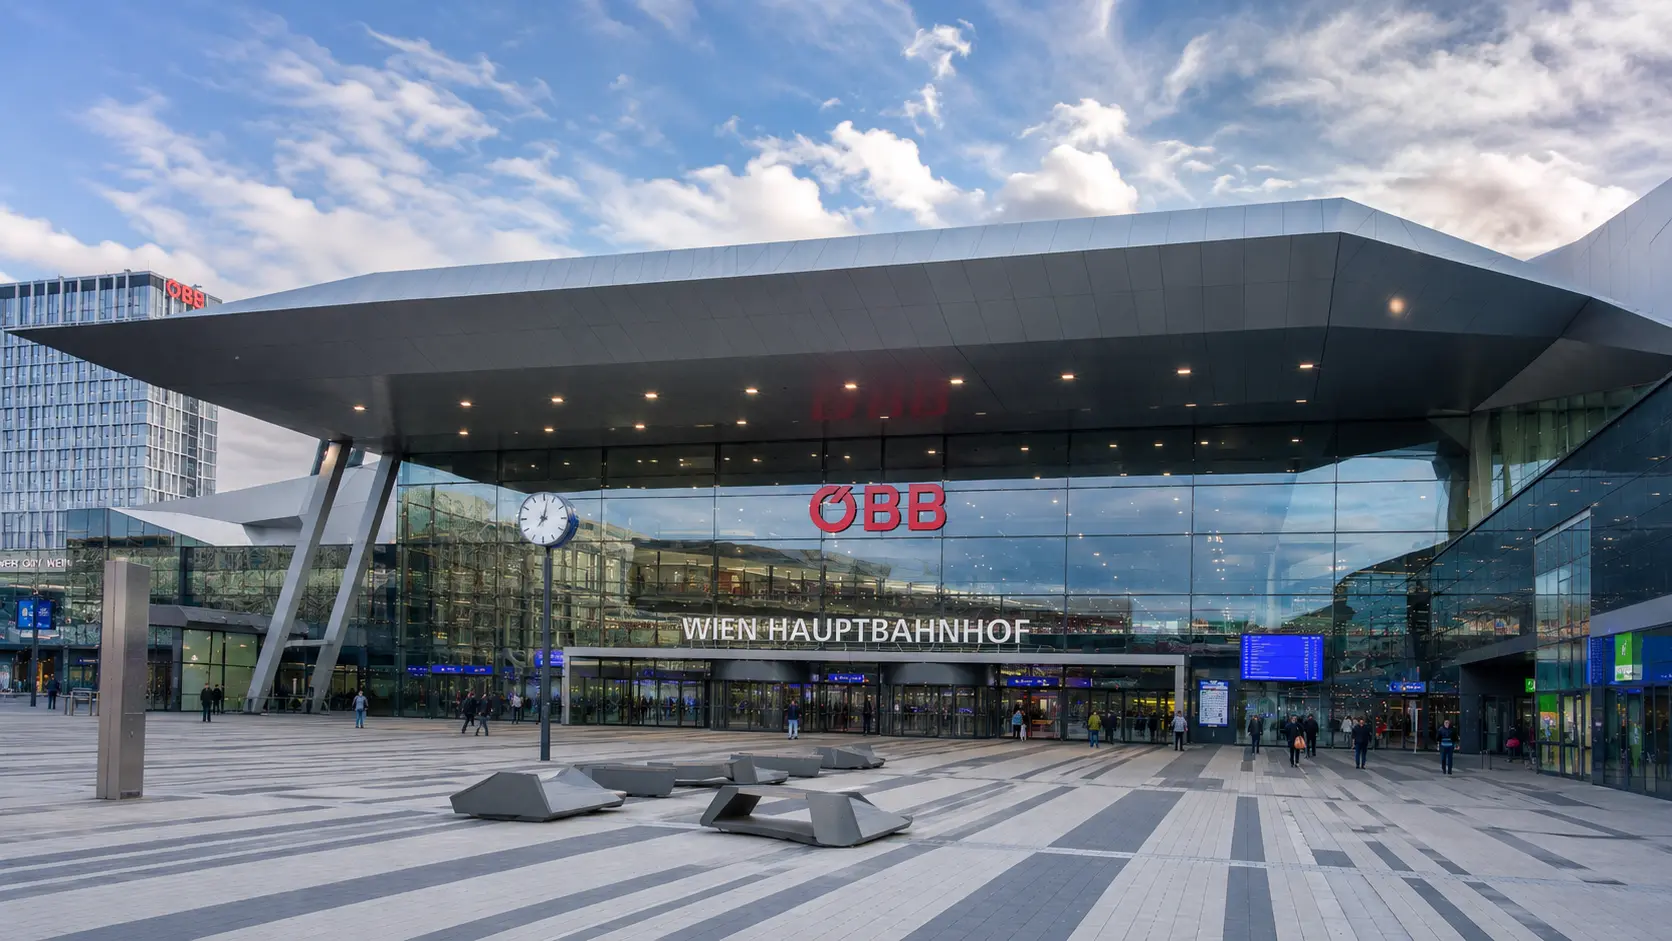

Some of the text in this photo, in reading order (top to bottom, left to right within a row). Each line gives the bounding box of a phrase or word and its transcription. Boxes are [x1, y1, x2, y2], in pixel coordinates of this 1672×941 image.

[809, 484, 947, 533] ÖBB
[682, 617, 1030, 644] WIEN HAUPTBAHNHOF
